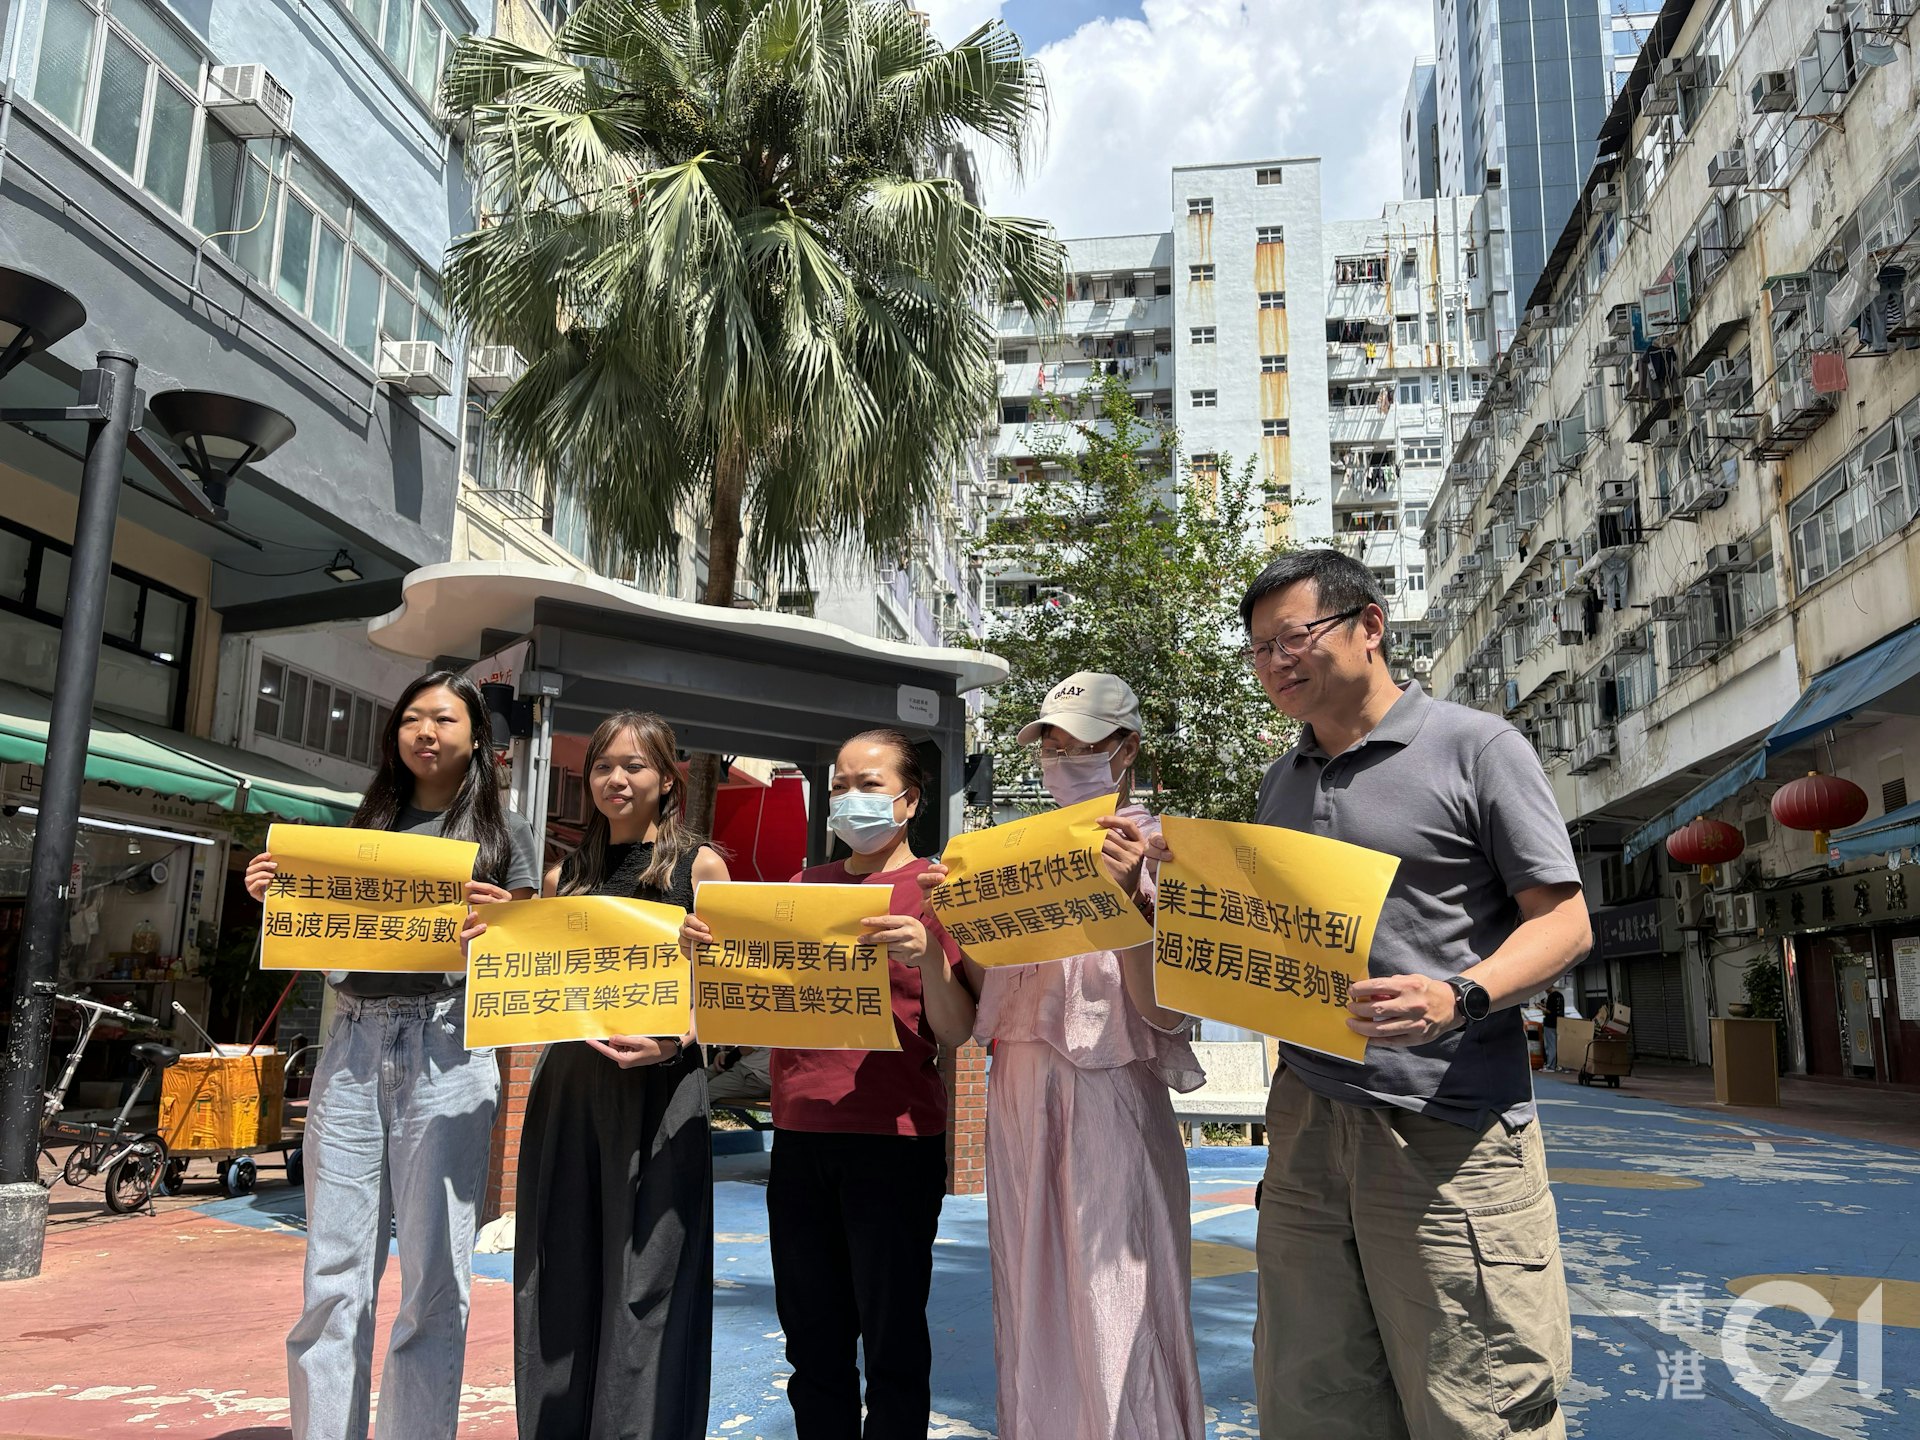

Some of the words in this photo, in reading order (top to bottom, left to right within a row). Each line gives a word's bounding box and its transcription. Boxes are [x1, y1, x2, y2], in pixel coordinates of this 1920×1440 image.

[269, 873, 462, 904] 業主逼遷好快到
[933, 846, 1098, 911] 業主逼遷好快到
[266, 911, 457, 943] 過渡房屋要夠數
[947, 891, 1127, 947] 過渡房屋要夠數
[1159, 878, 1361, 954] 業主逼遷好快到
[474, 941, 678, 980] 告別劏房要有序
[696, 938, 877, 972] 告別劏房要有序
[1156, 931, 1356, 1008] 過渡房屋要夠數
[472, 980, 678, 1018] 原區安置樂安居
[699, 982, 882, 1016] 原區安置樂安居
